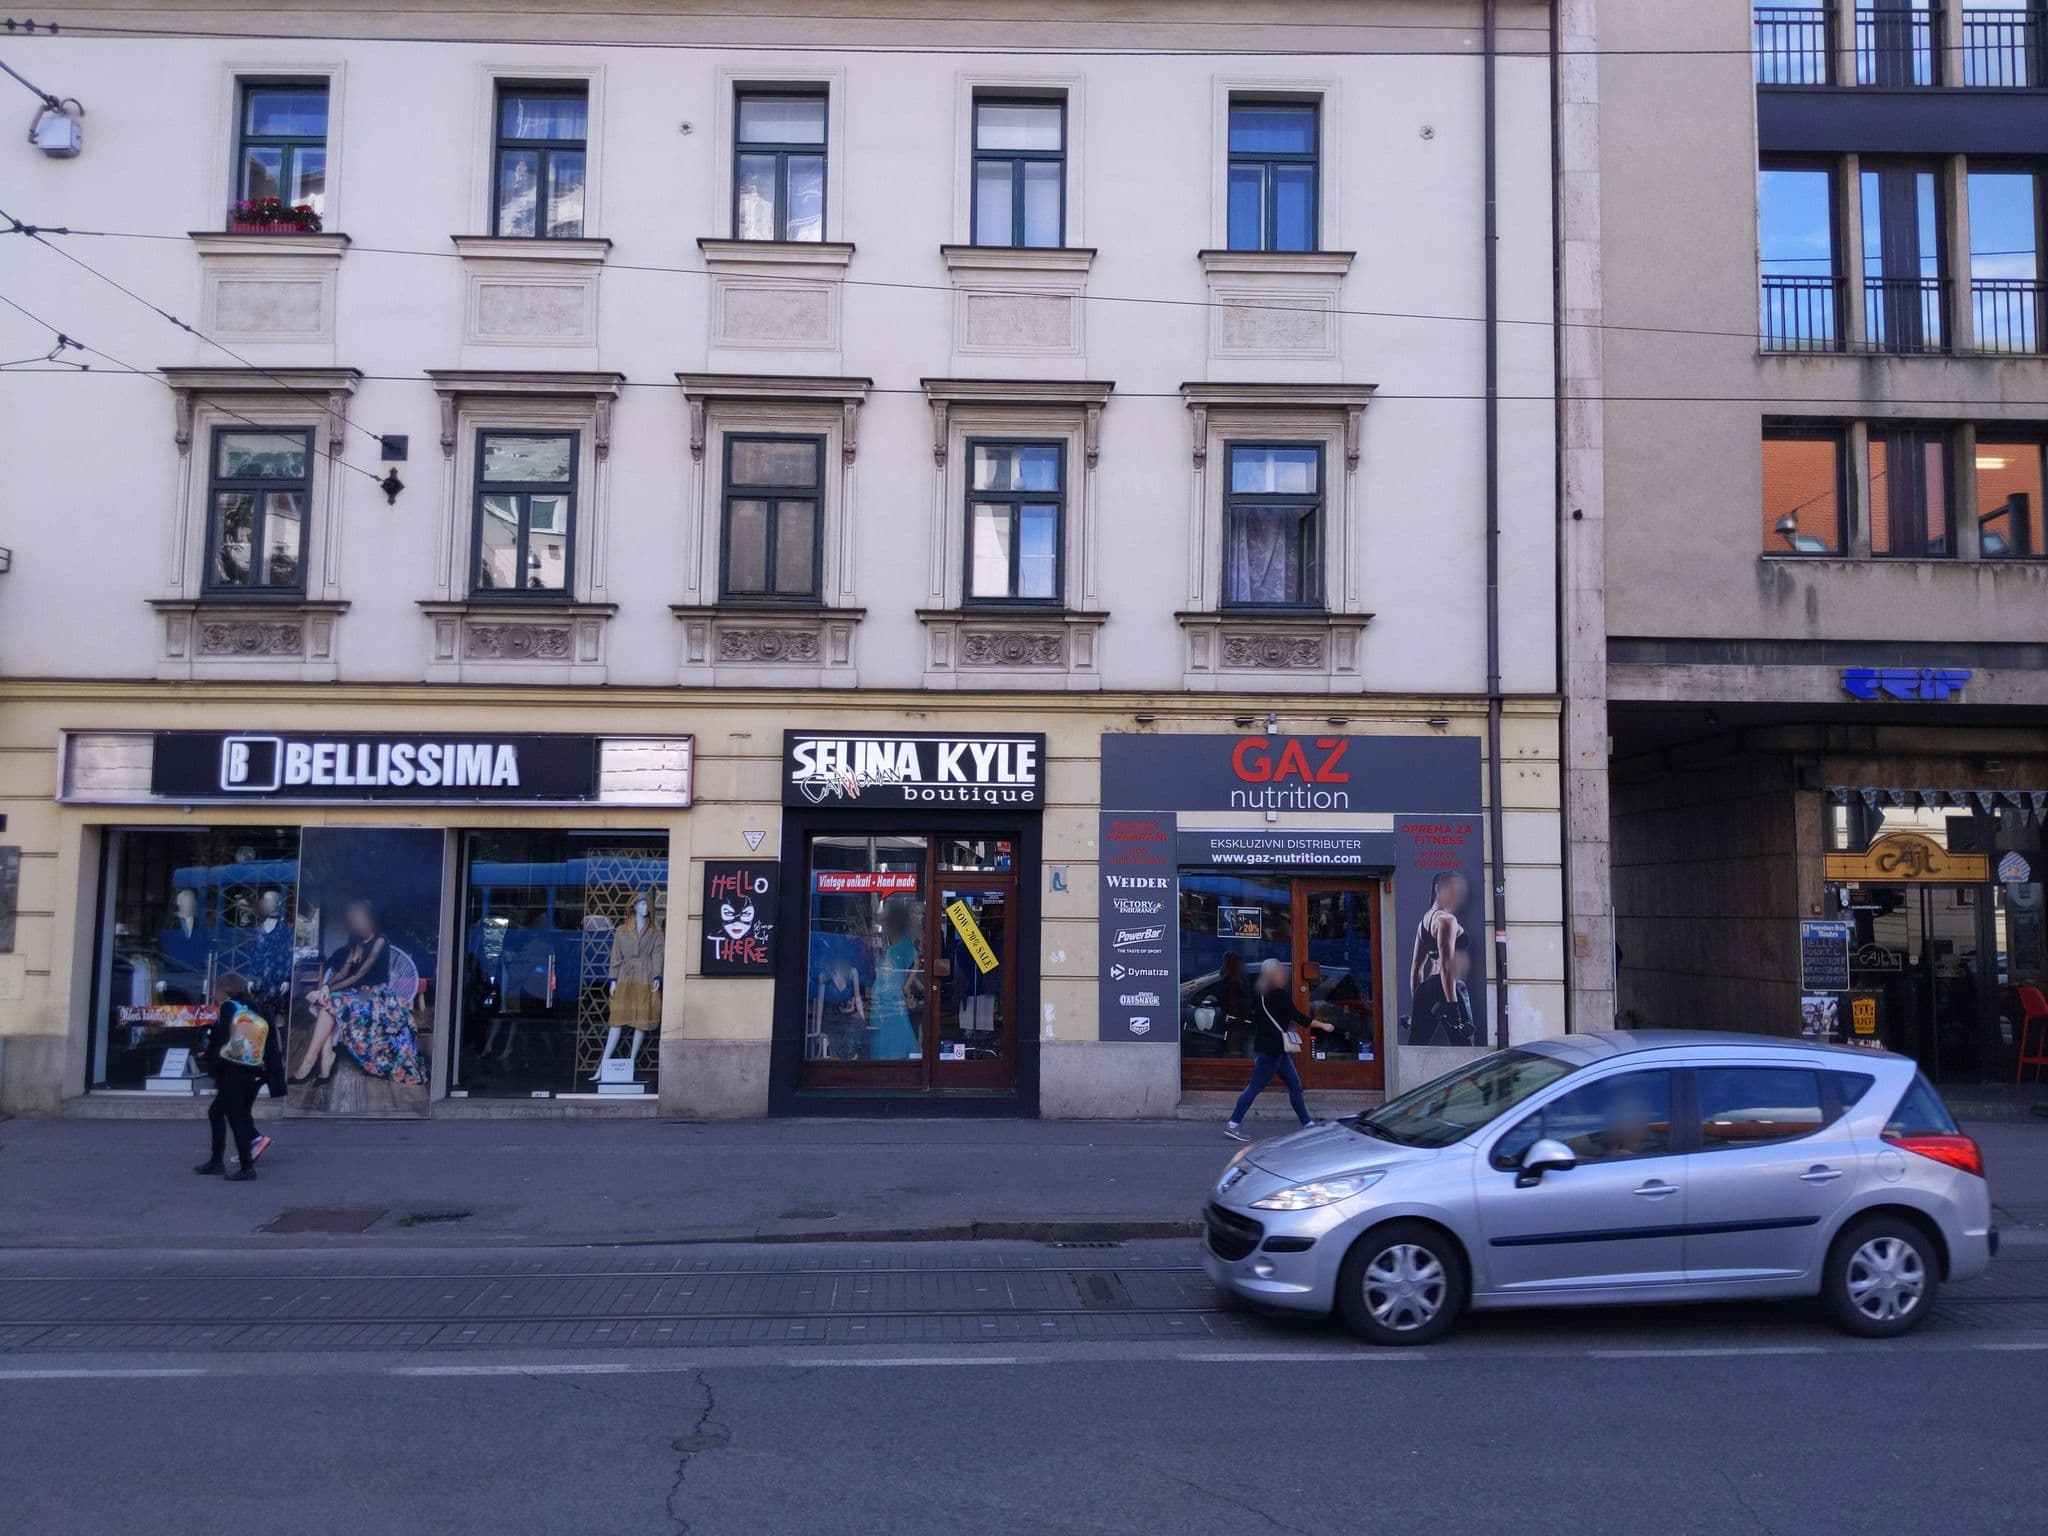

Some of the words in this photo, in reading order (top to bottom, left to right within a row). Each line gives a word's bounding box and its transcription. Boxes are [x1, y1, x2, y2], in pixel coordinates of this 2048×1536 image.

[285, 743, 520, 786] BELLISSIMA
[792, 741, 922, 781] SELINA
[937, 743, 1036, 782] KYLE
[1231, 737, 1349, 783] GAZ
[903, 786, 1034, 804] boutique
[1231, 784, 1349, 809] nutrition
[1210, 839, 1284, 849] EKSKLUZIVNI
[1288, 839, 1361, 849] DISTRIBUTER
[1414, 836, 1464, 846] FITNESS
[1211, 852, 1362, 865] www.gaz-nutrition.com
[711, 870, 768, 899] HELLO
[819, 875, 845, 891] Vintage
[846, 875, 871, 888] unikati
[877, 875, 896, 888] Hand
[896, 875, 915, 888] made
[1113, 900, 1153, 908] VICTORY
[953, 906, 968, 927] WOW
[976, 946, 993, 968] SALE
[1117, 928, 1162, 942] PowerBar
[707, 935, 768, 964] THERE
[1128, 968, 1169, 977] Dymatize
